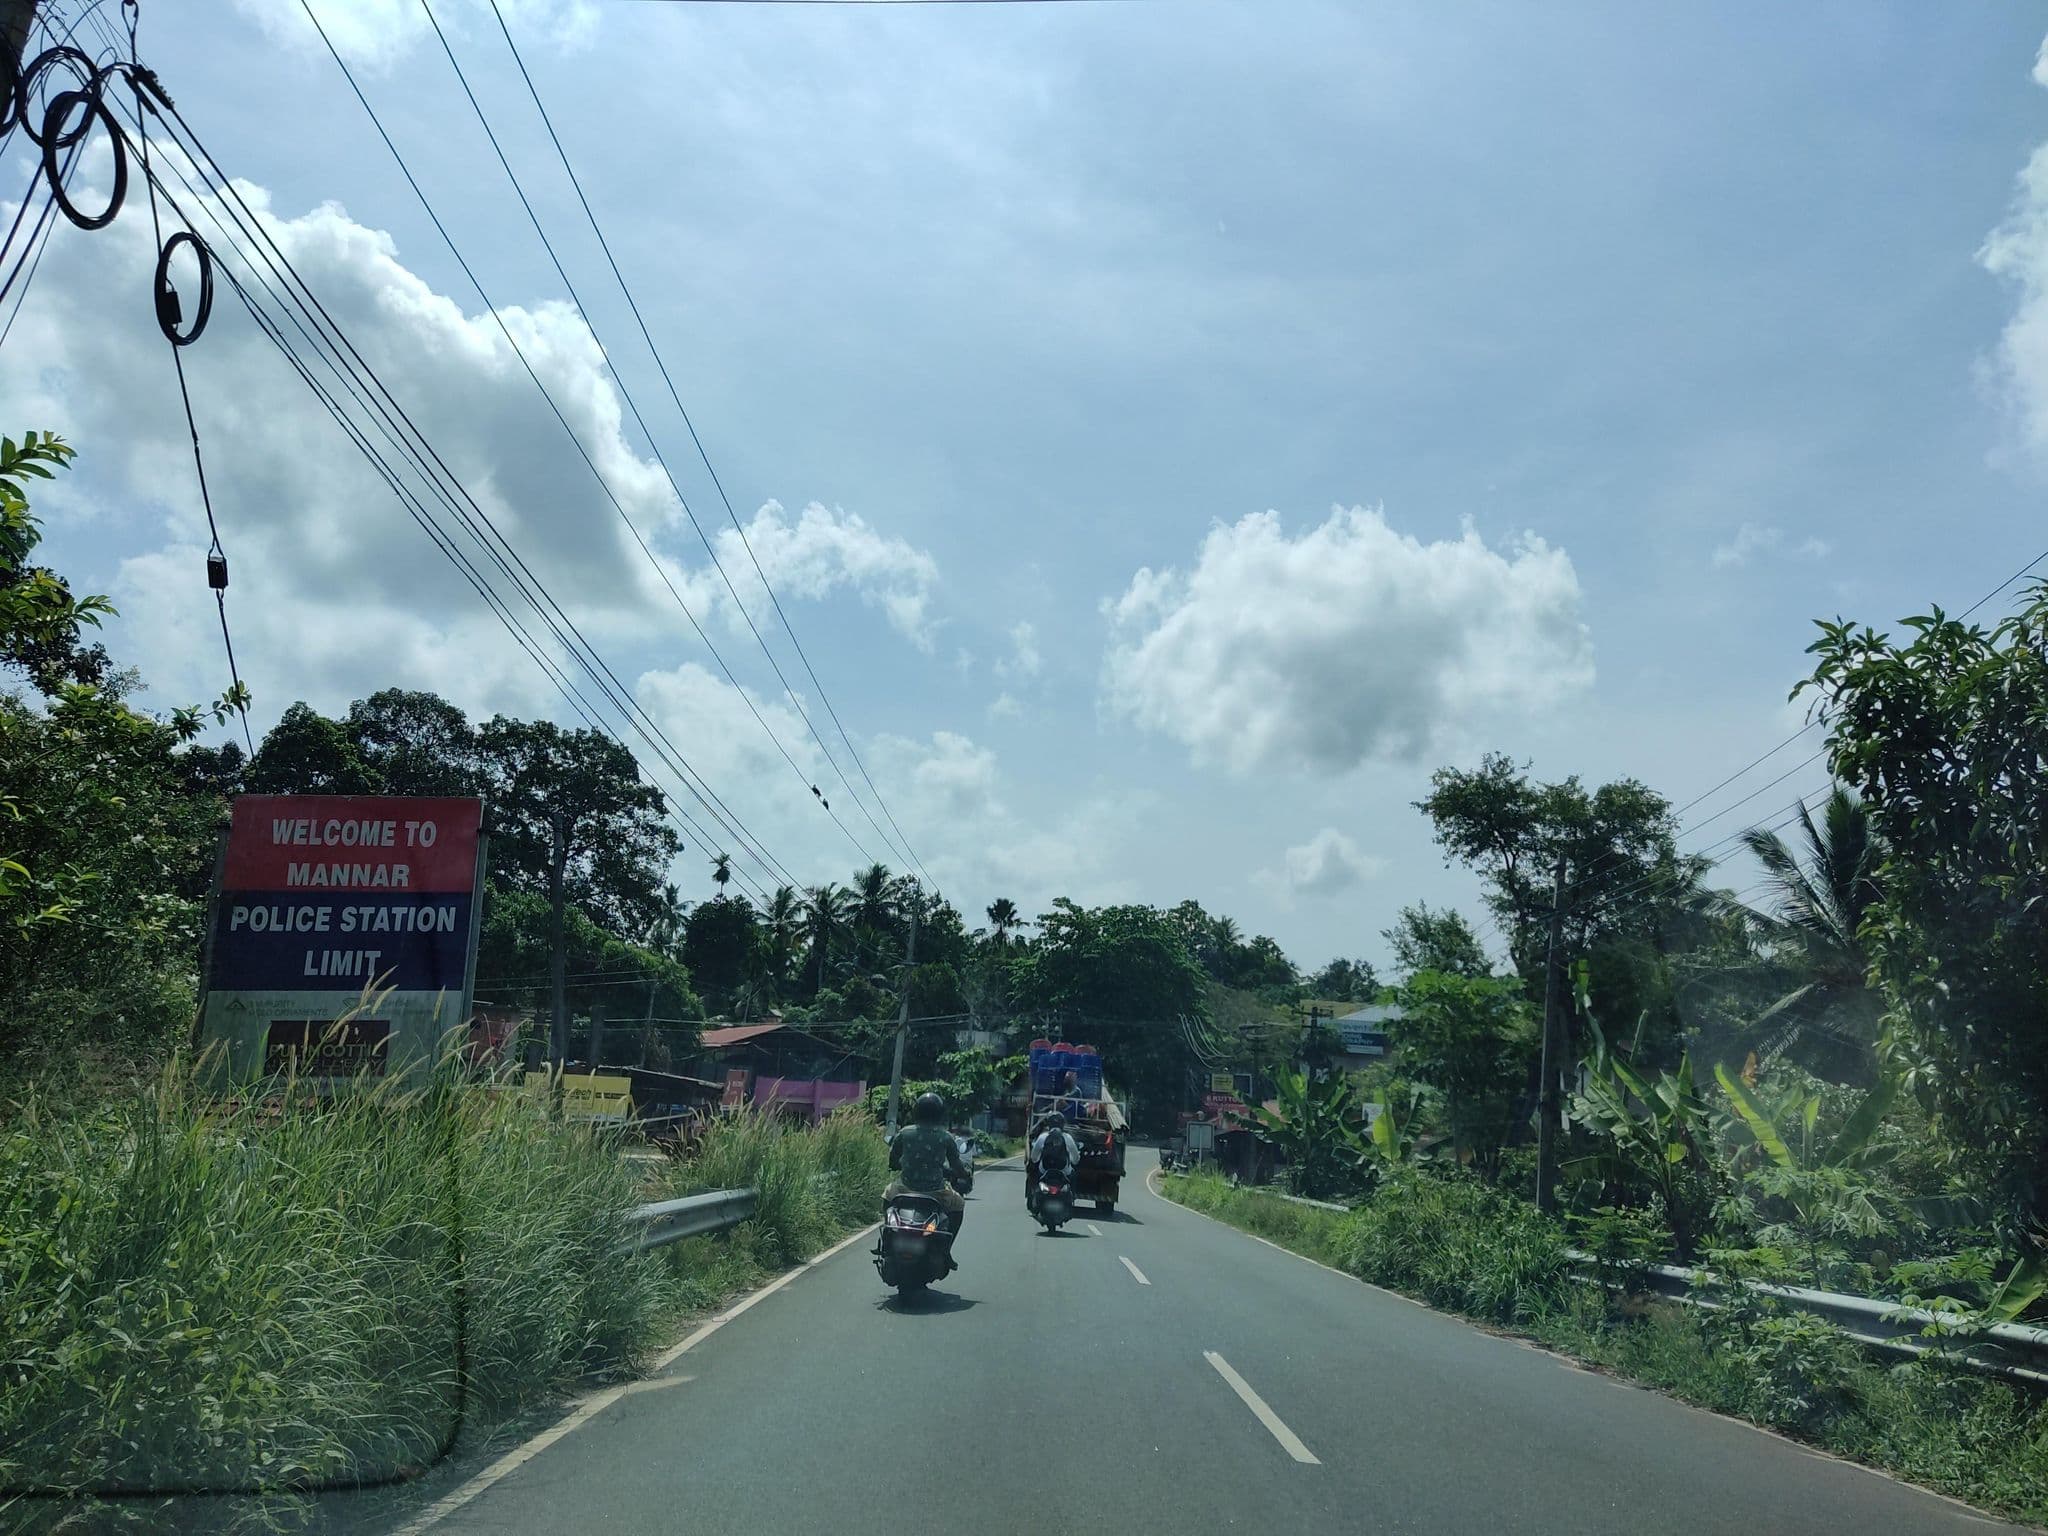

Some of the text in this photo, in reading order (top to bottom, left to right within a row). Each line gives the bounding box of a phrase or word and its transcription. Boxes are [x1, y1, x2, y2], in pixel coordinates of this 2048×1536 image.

[272, 819, 437, 847] WELCOME TO
[286, 862, 411, 888] MANNAR
[230, 905, 456, 932] POLICE STATION
[304, 950, 382, 976] LIMIT
